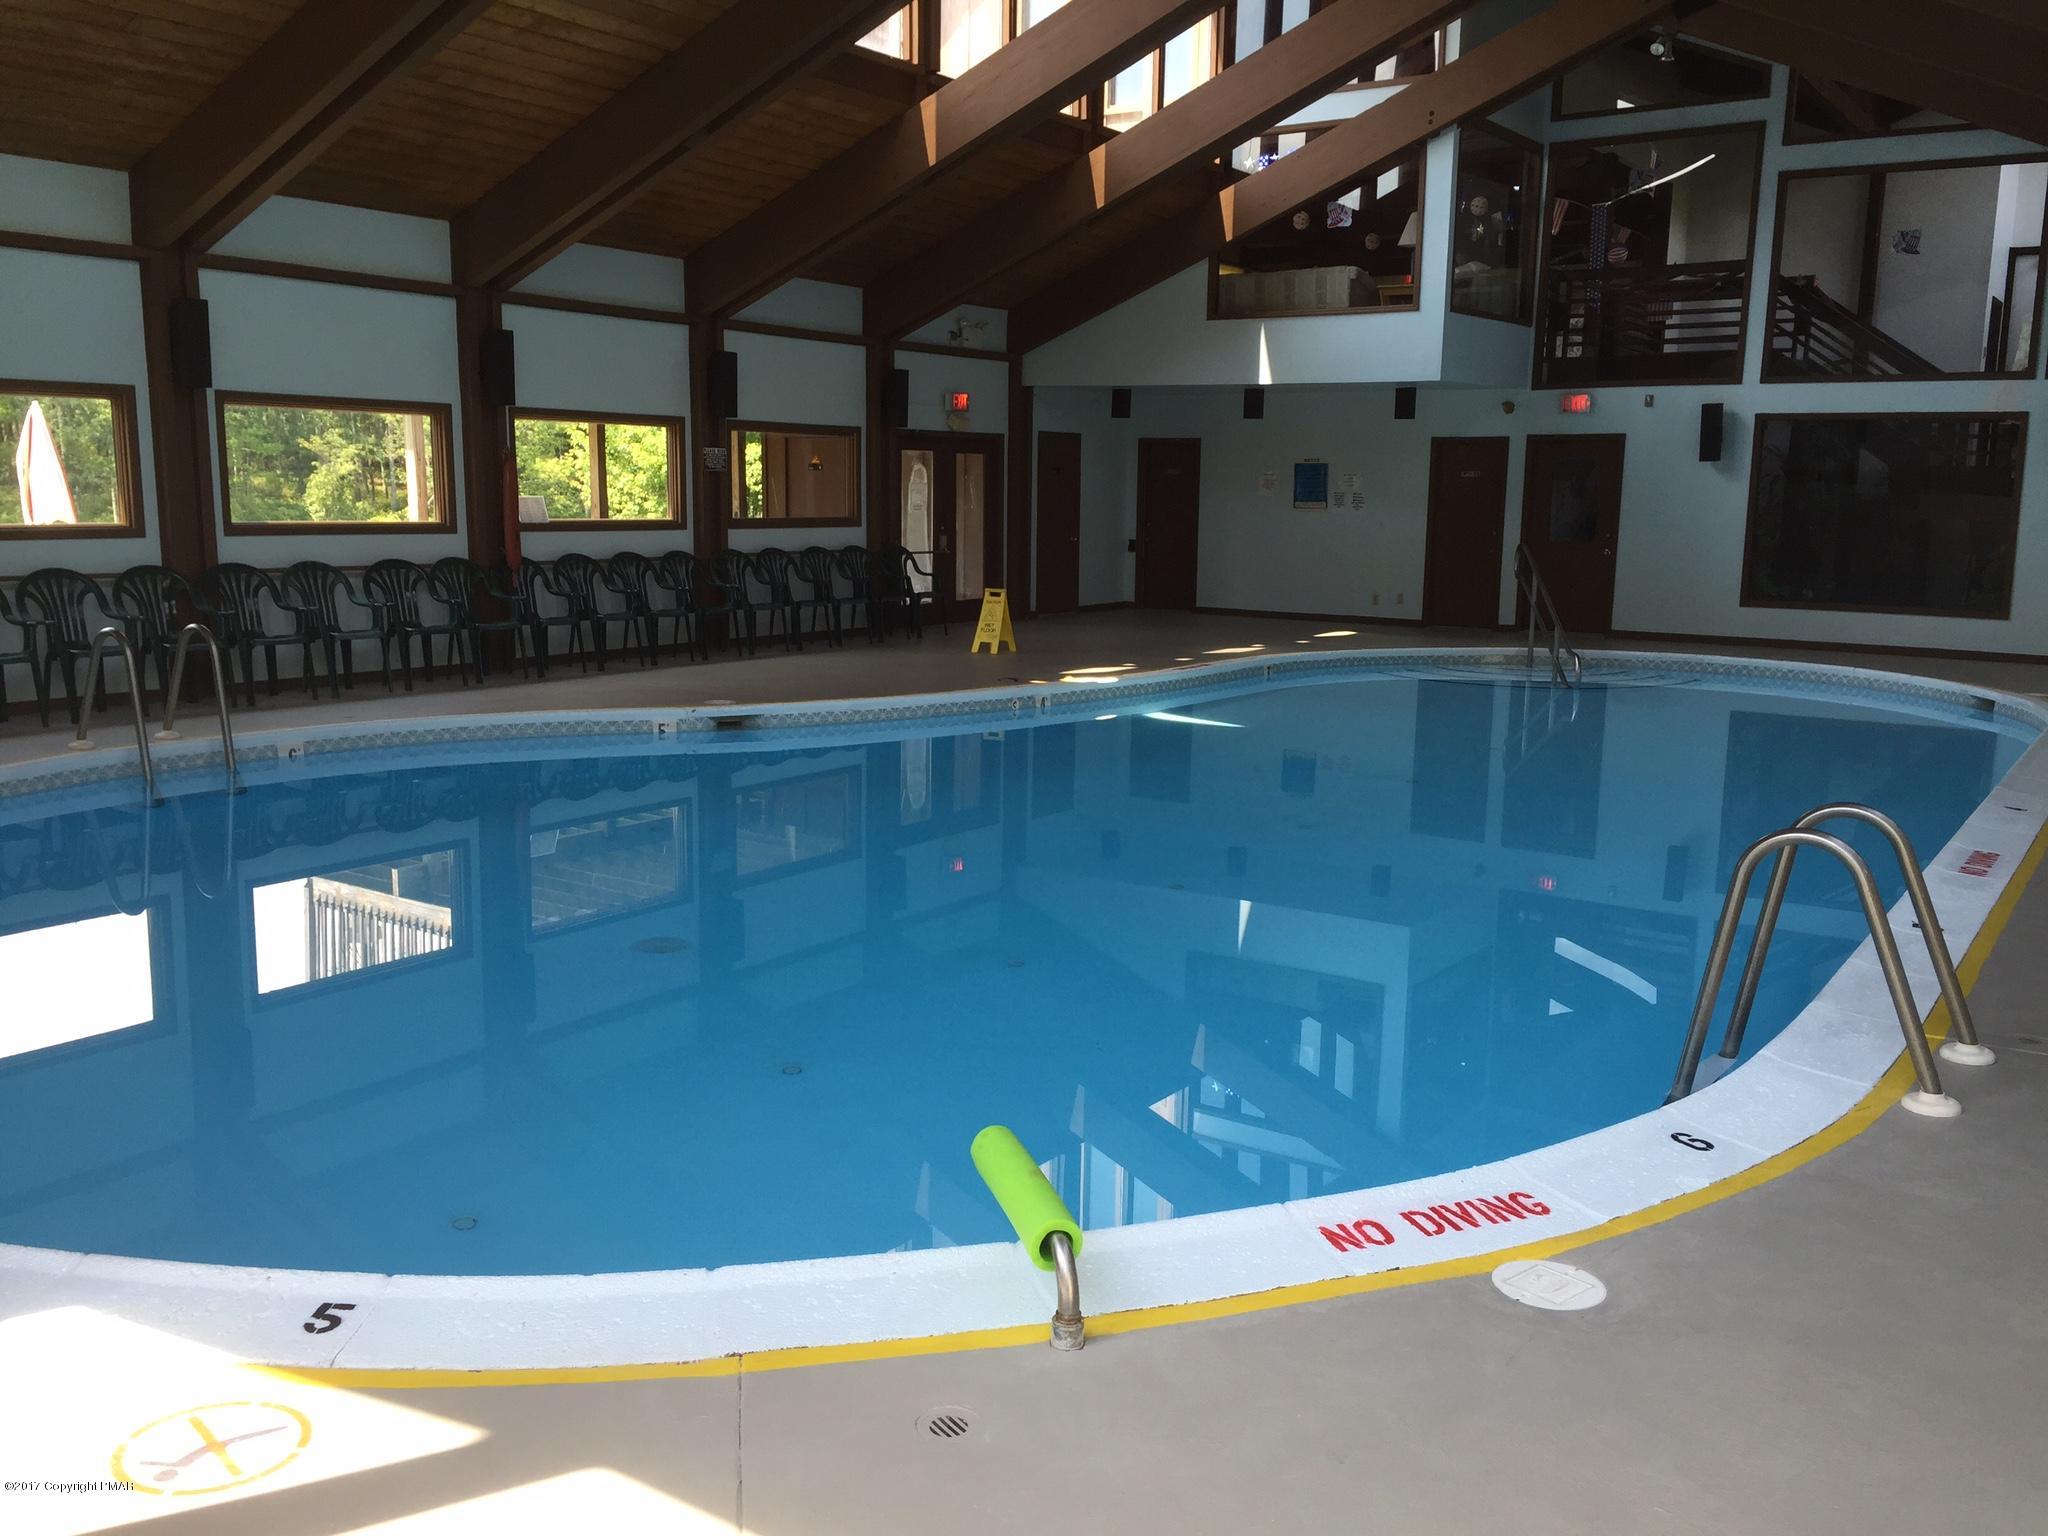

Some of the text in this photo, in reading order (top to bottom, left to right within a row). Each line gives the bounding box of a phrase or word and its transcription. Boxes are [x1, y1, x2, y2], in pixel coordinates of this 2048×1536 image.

[953, 393, 968, 409] EXIT
[1670, 1132, 1715, 1152] 6
[1317, 1191, 1551, 1253] NO DIVING
[303, 1302, 357, 1334] 5
